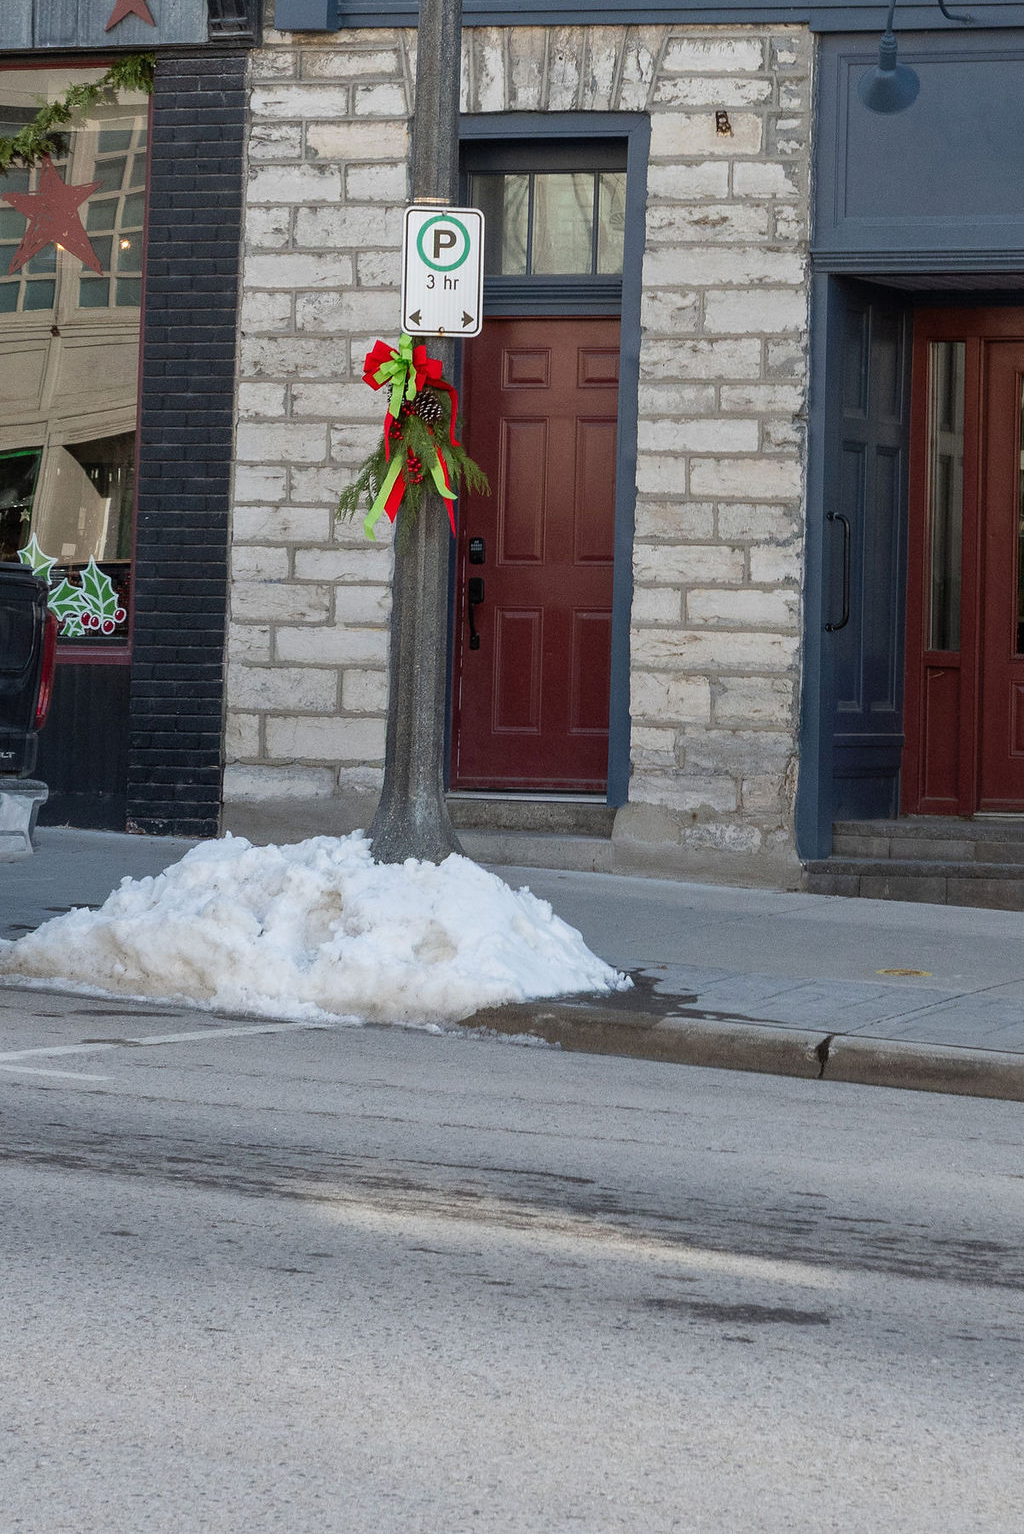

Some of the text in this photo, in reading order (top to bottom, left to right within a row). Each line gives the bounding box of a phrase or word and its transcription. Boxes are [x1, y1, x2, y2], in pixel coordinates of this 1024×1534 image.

[433, 229, 457, 258] P
[426, 274, 459, 290] 3 hr
[0, 751, 16, 759] LT
